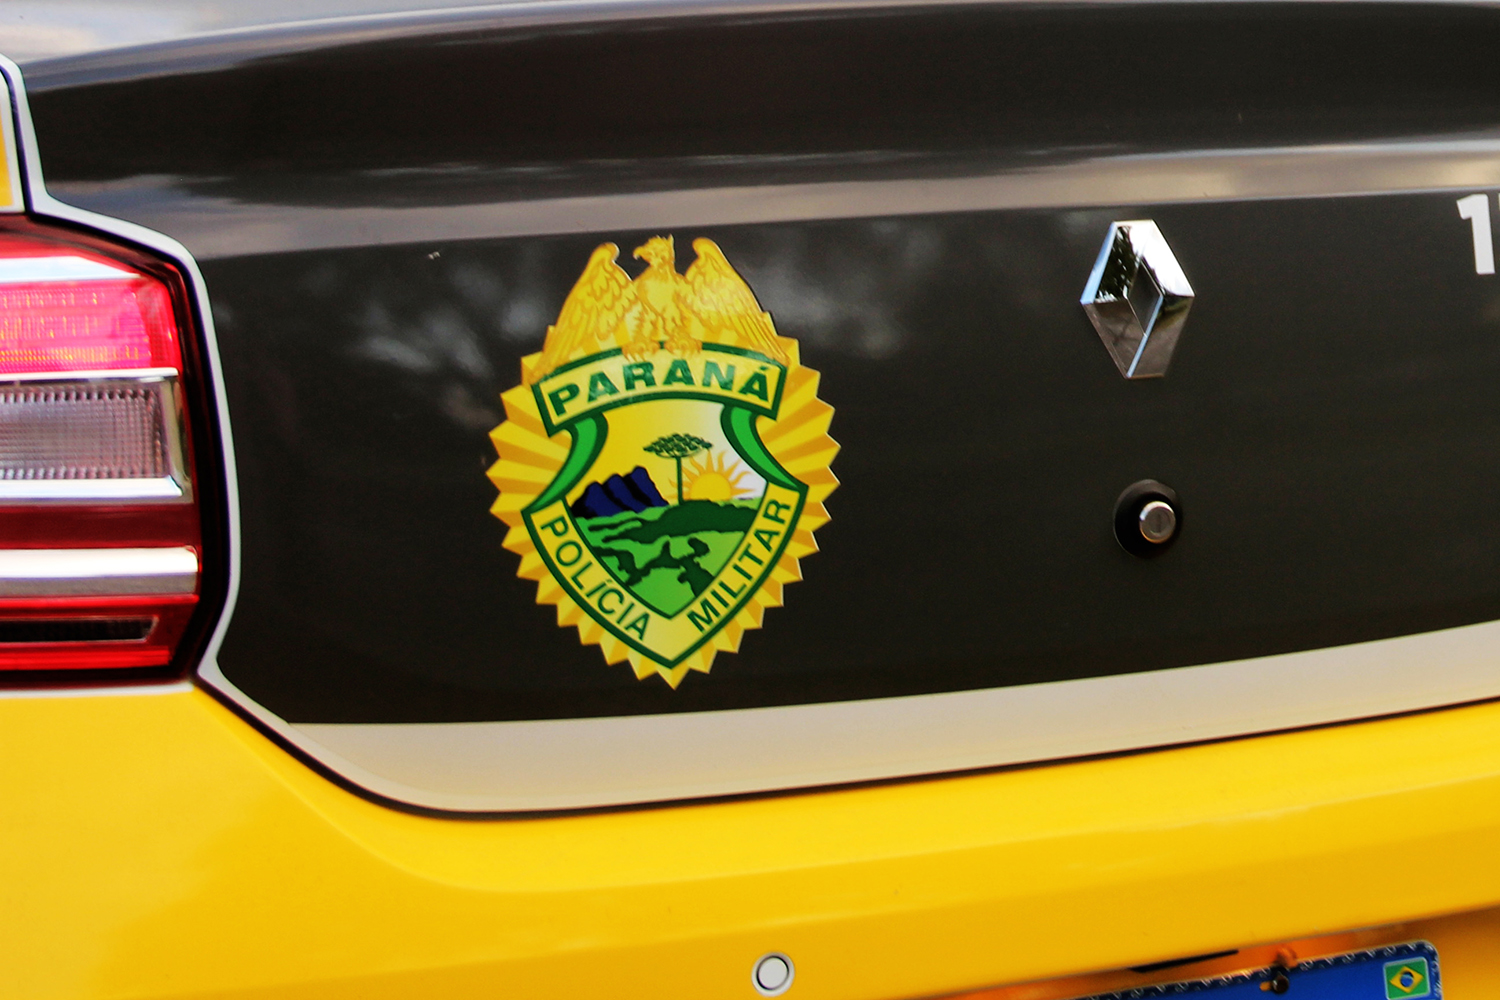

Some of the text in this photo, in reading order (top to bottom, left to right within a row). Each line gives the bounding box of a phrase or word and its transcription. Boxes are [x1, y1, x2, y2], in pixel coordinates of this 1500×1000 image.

[549, 358, 773, 417] PARANÁ
[541, 497, 792, 641] POLÍCIA MILITAR
